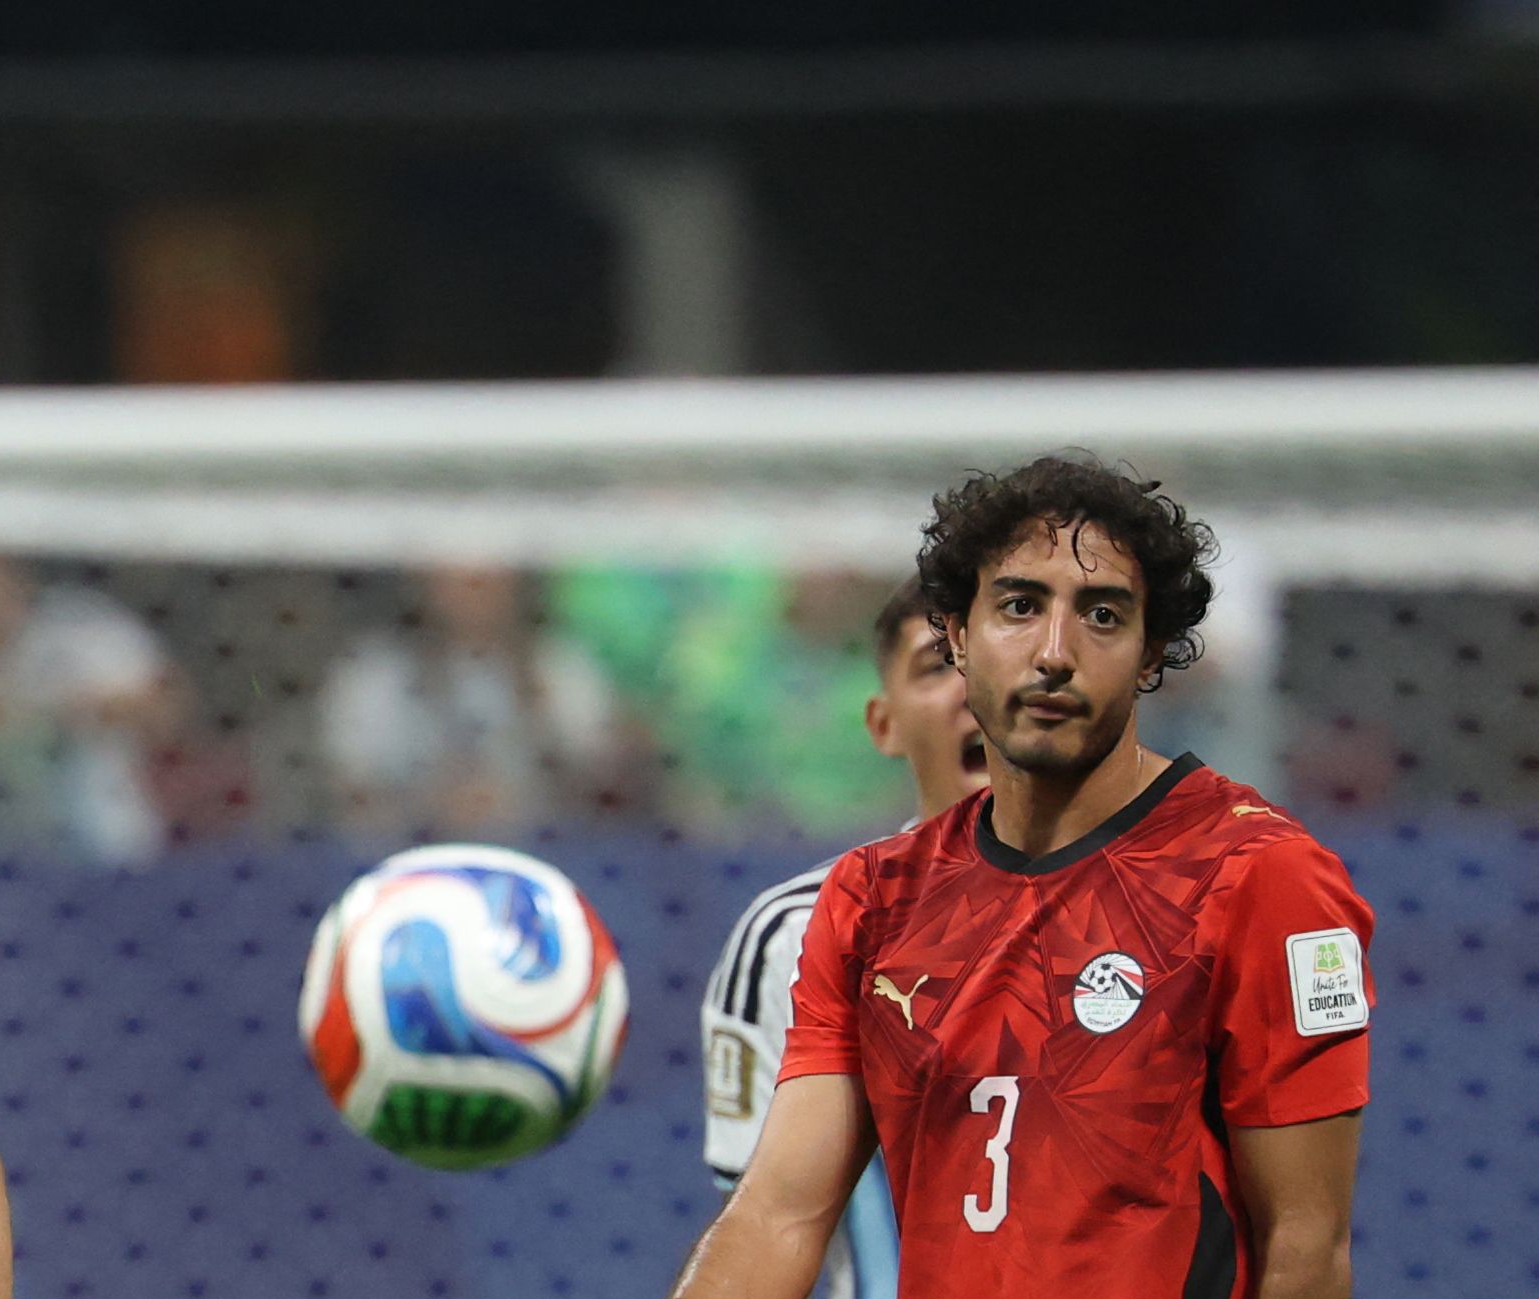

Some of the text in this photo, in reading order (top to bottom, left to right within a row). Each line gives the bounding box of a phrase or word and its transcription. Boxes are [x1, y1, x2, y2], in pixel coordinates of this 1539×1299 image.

[1308, 993, 1357, 1012] EDUCATION
[1325, 1011, 1345, 1020] FIFA
[964, 1075, 1019, 1233] 3
